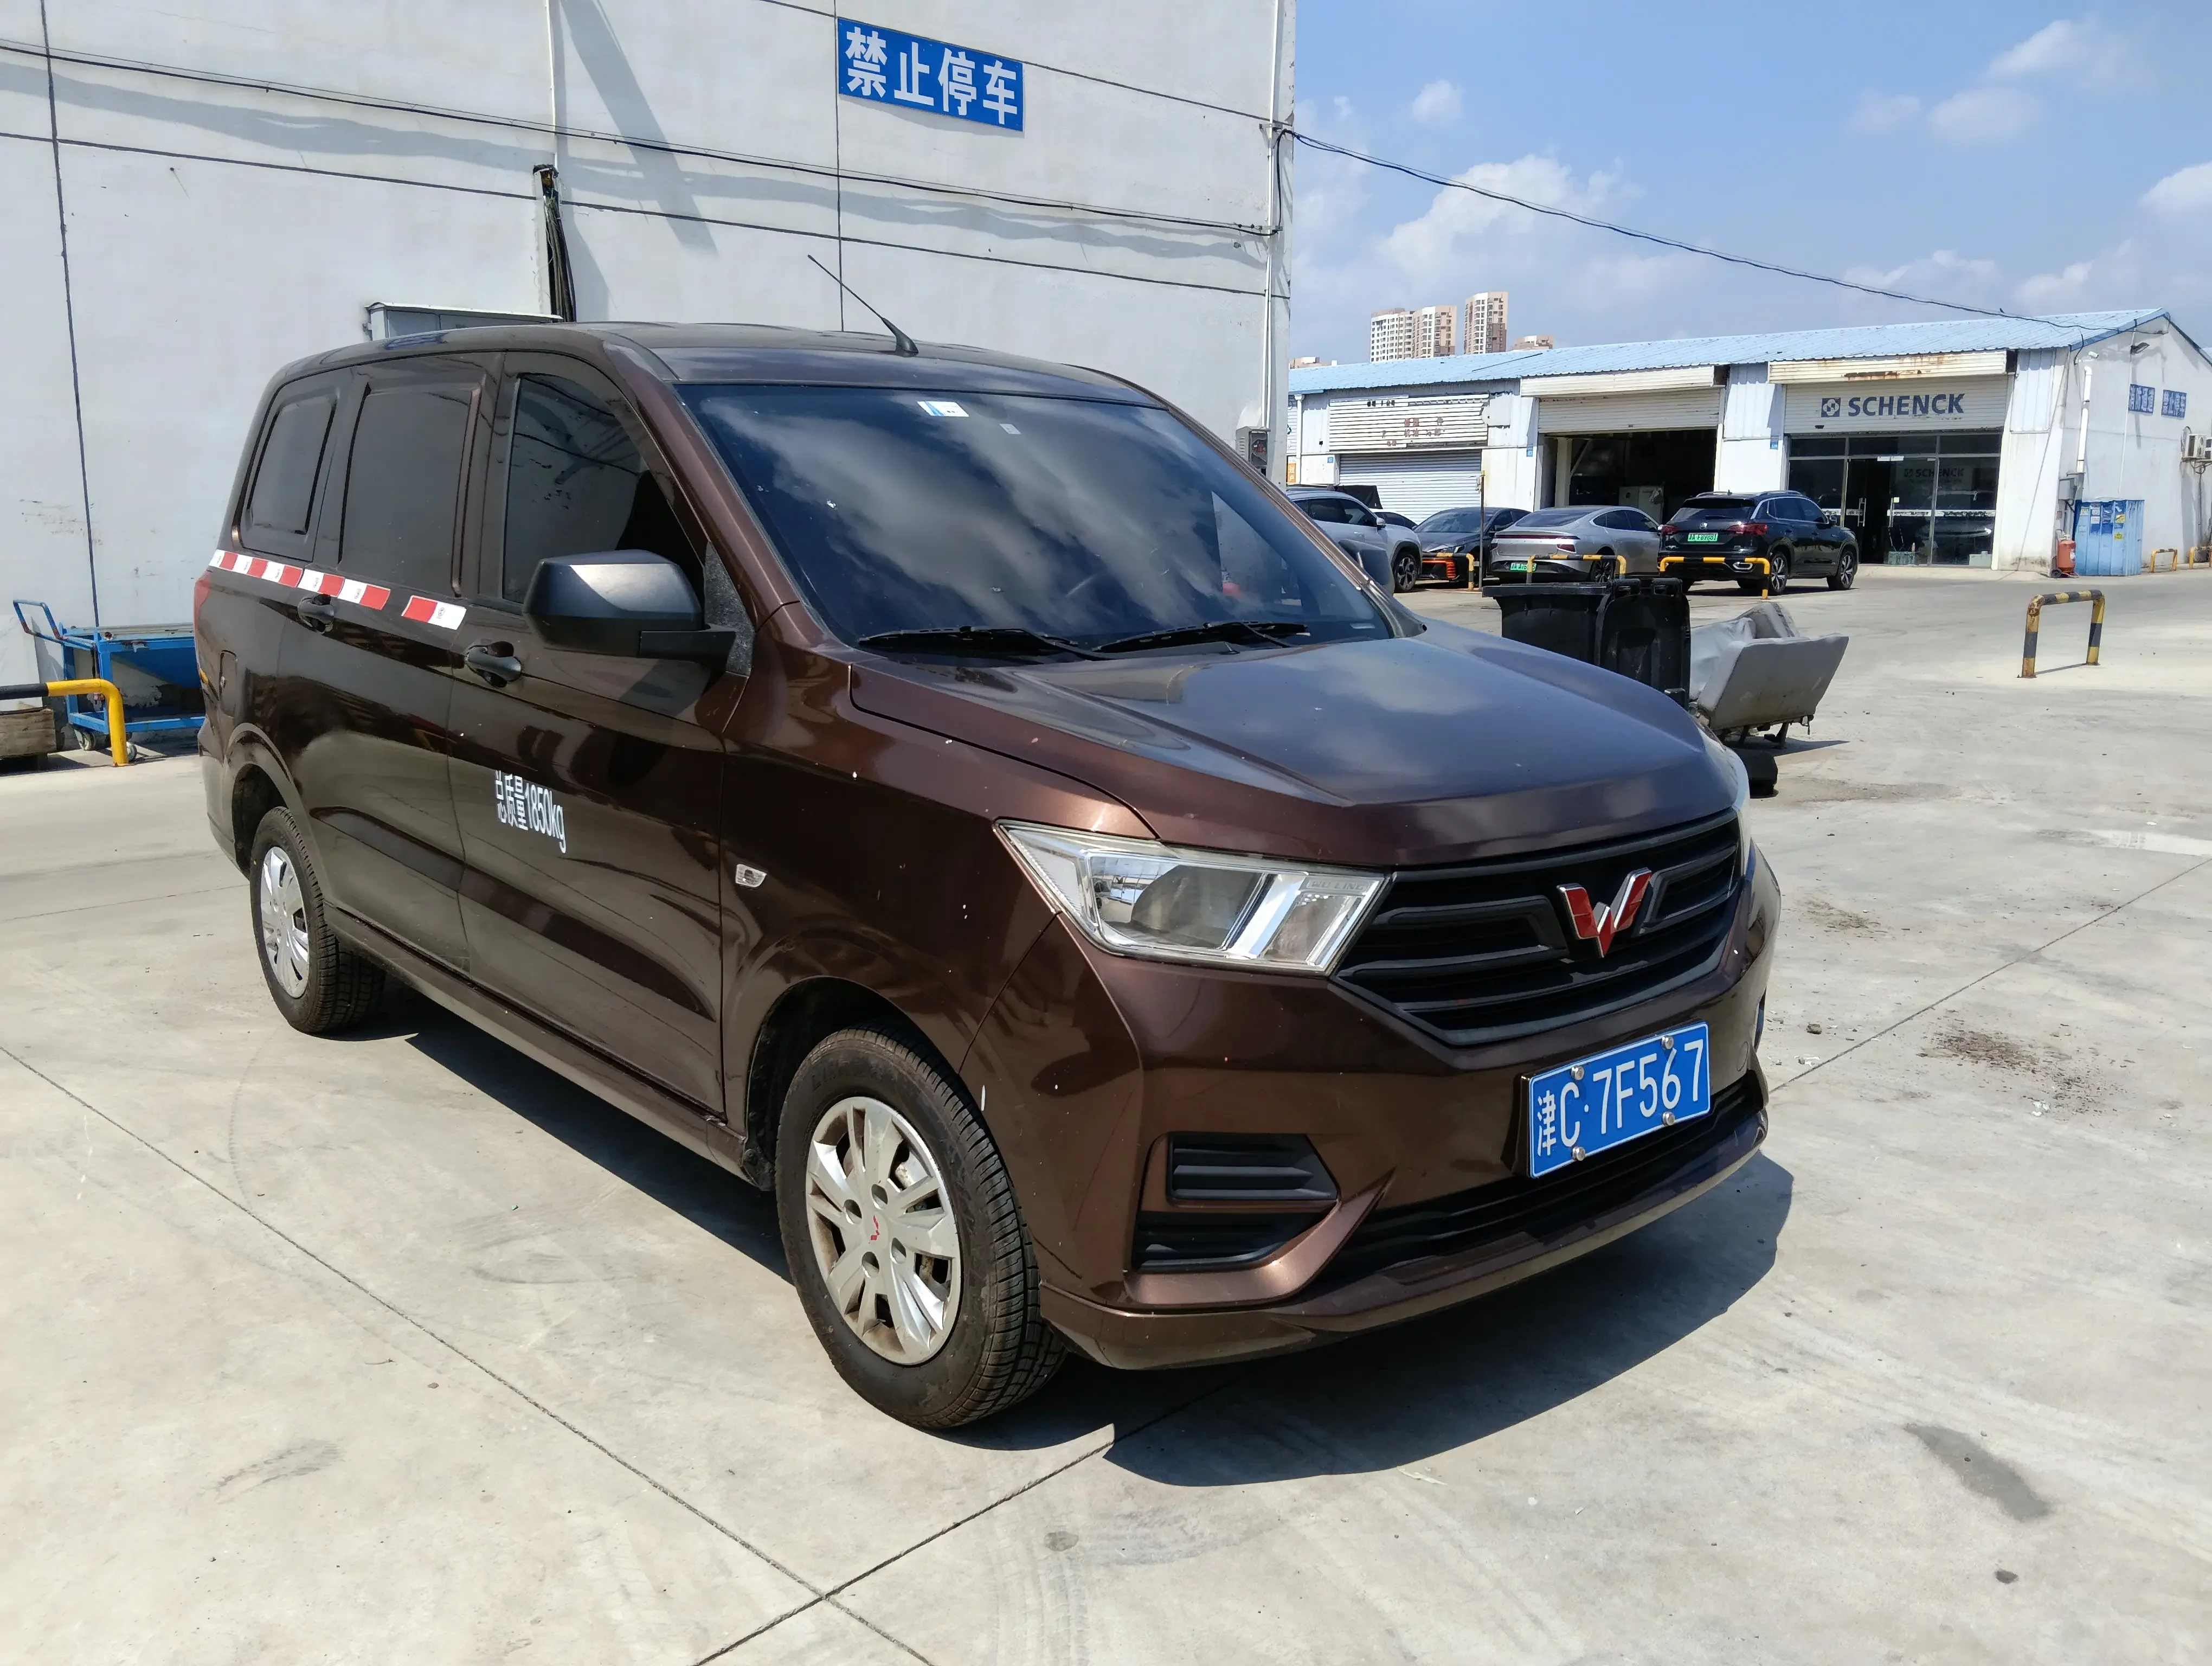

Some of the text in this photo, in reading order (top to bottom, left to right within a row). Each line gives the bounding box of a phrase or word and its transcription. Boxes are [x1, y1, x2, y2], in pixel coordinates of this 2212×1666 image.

[845, 26, 1018, 125] 禁止停车
[1848, 393, 1966, 417] SCHENCK
